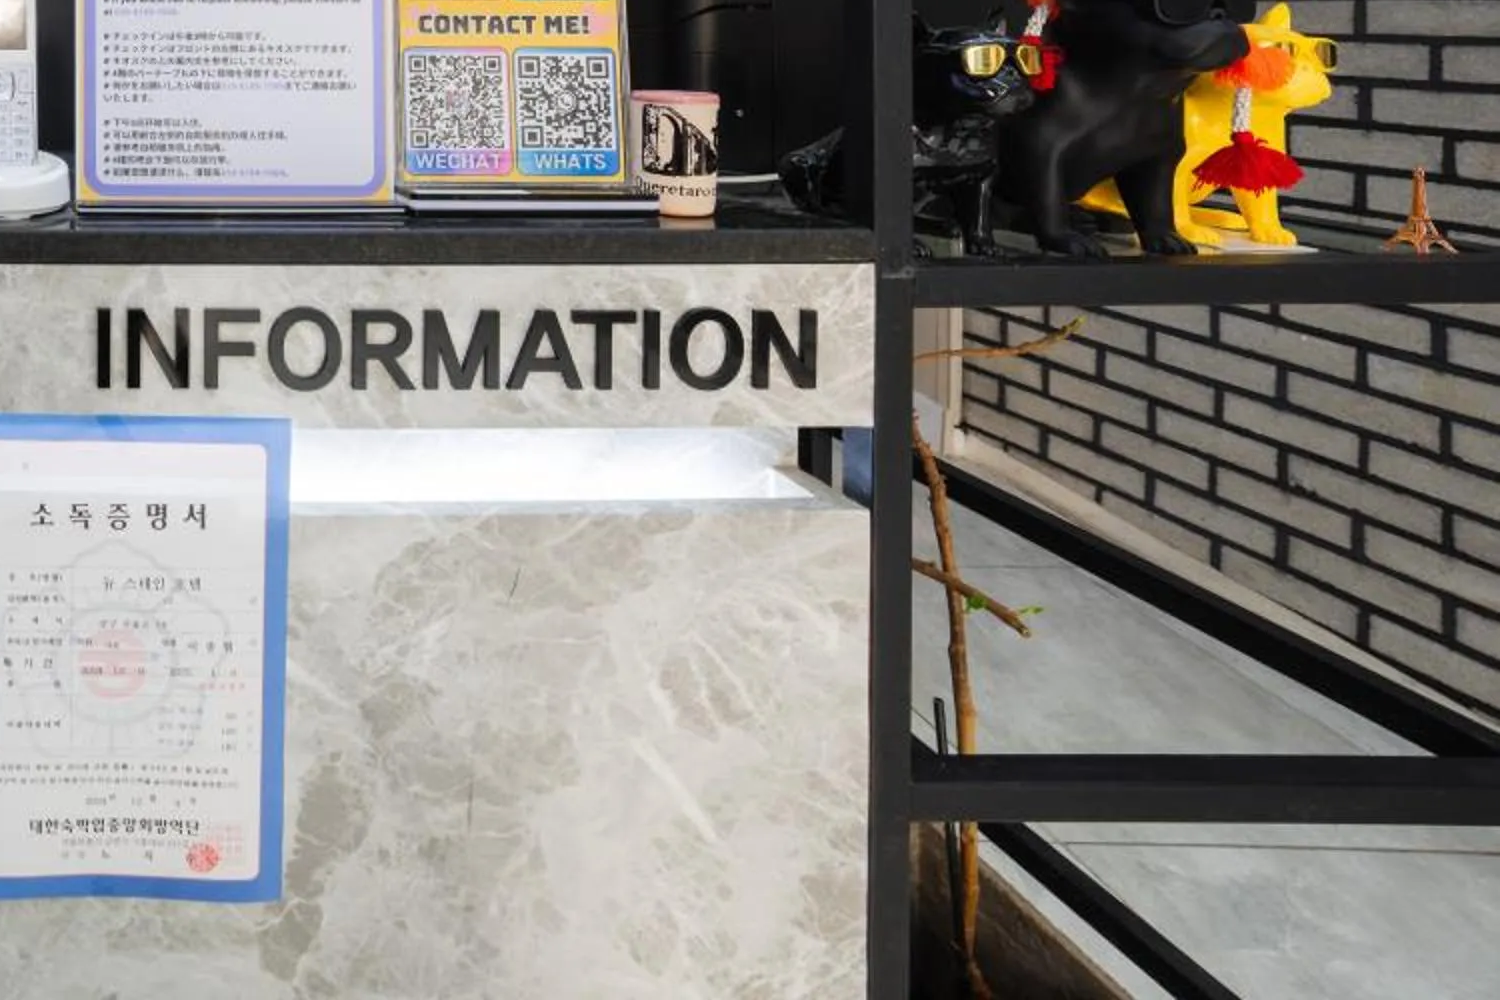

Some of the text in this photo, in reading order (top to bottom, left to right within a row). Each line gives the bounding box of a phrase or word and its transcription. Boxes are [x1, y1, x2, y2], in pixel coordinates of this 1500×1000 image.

[418, 14, 591, 35] CONTACT ME!
[415, 153, 502, 171] WECHAT
[534, 154, 607, 171] WHATS
[95, 305, 819, 391] INFORMATION
